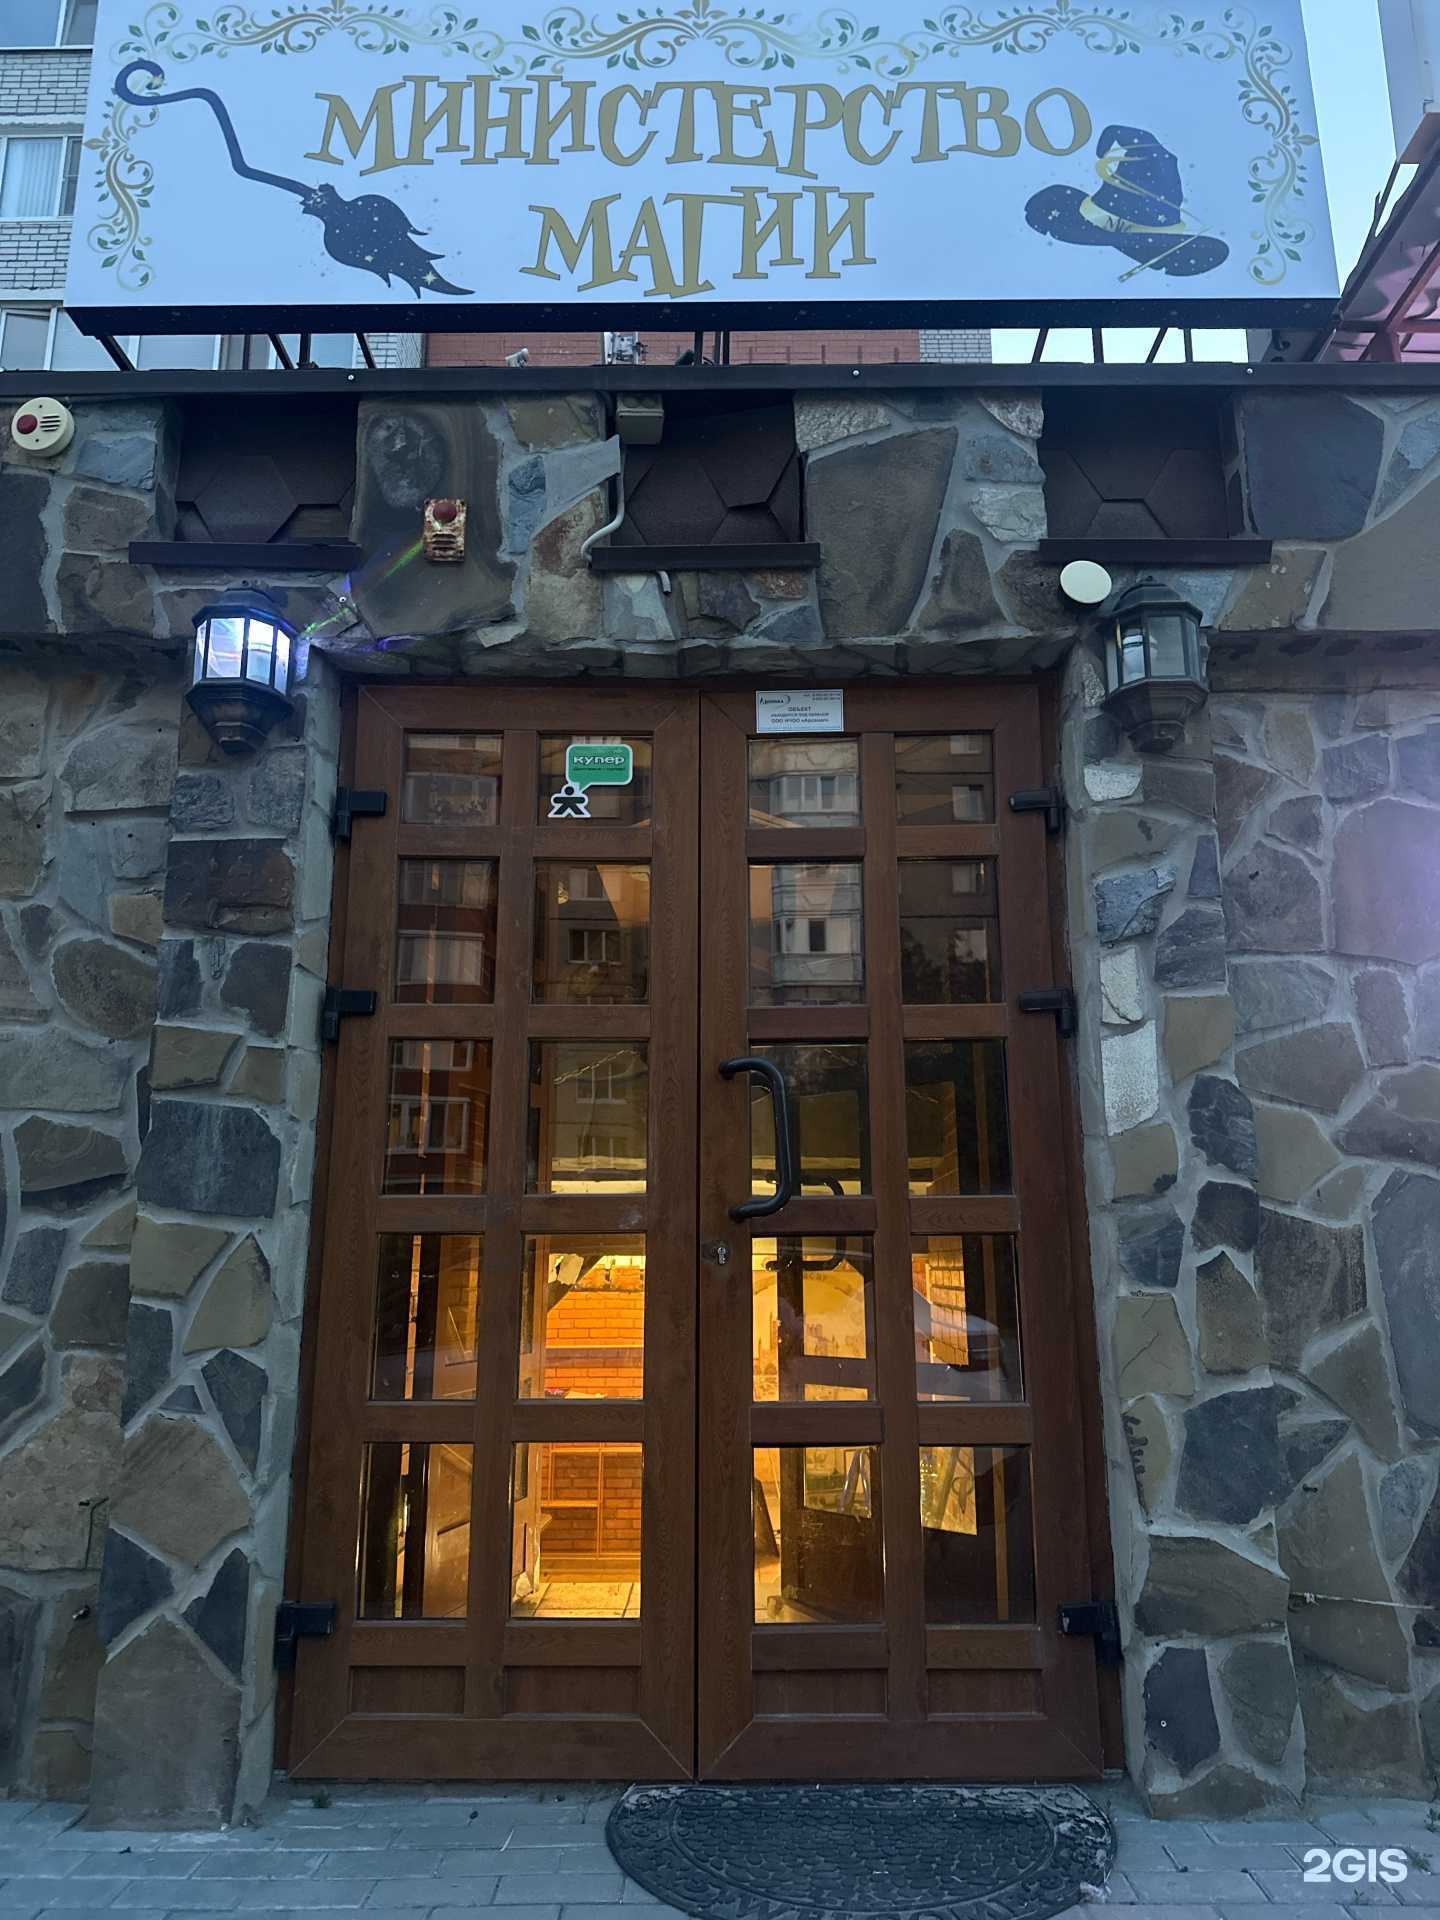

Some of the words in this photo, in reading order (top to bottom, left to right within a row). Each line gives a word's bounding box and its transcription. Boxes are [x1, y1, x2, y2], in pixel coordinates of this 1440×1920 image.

[304, 75, 1093, 180] МИНИСТЕРСТВО
[519, 186, 876, 299] МАГИИ
[573, 755, 625, 765] купер
